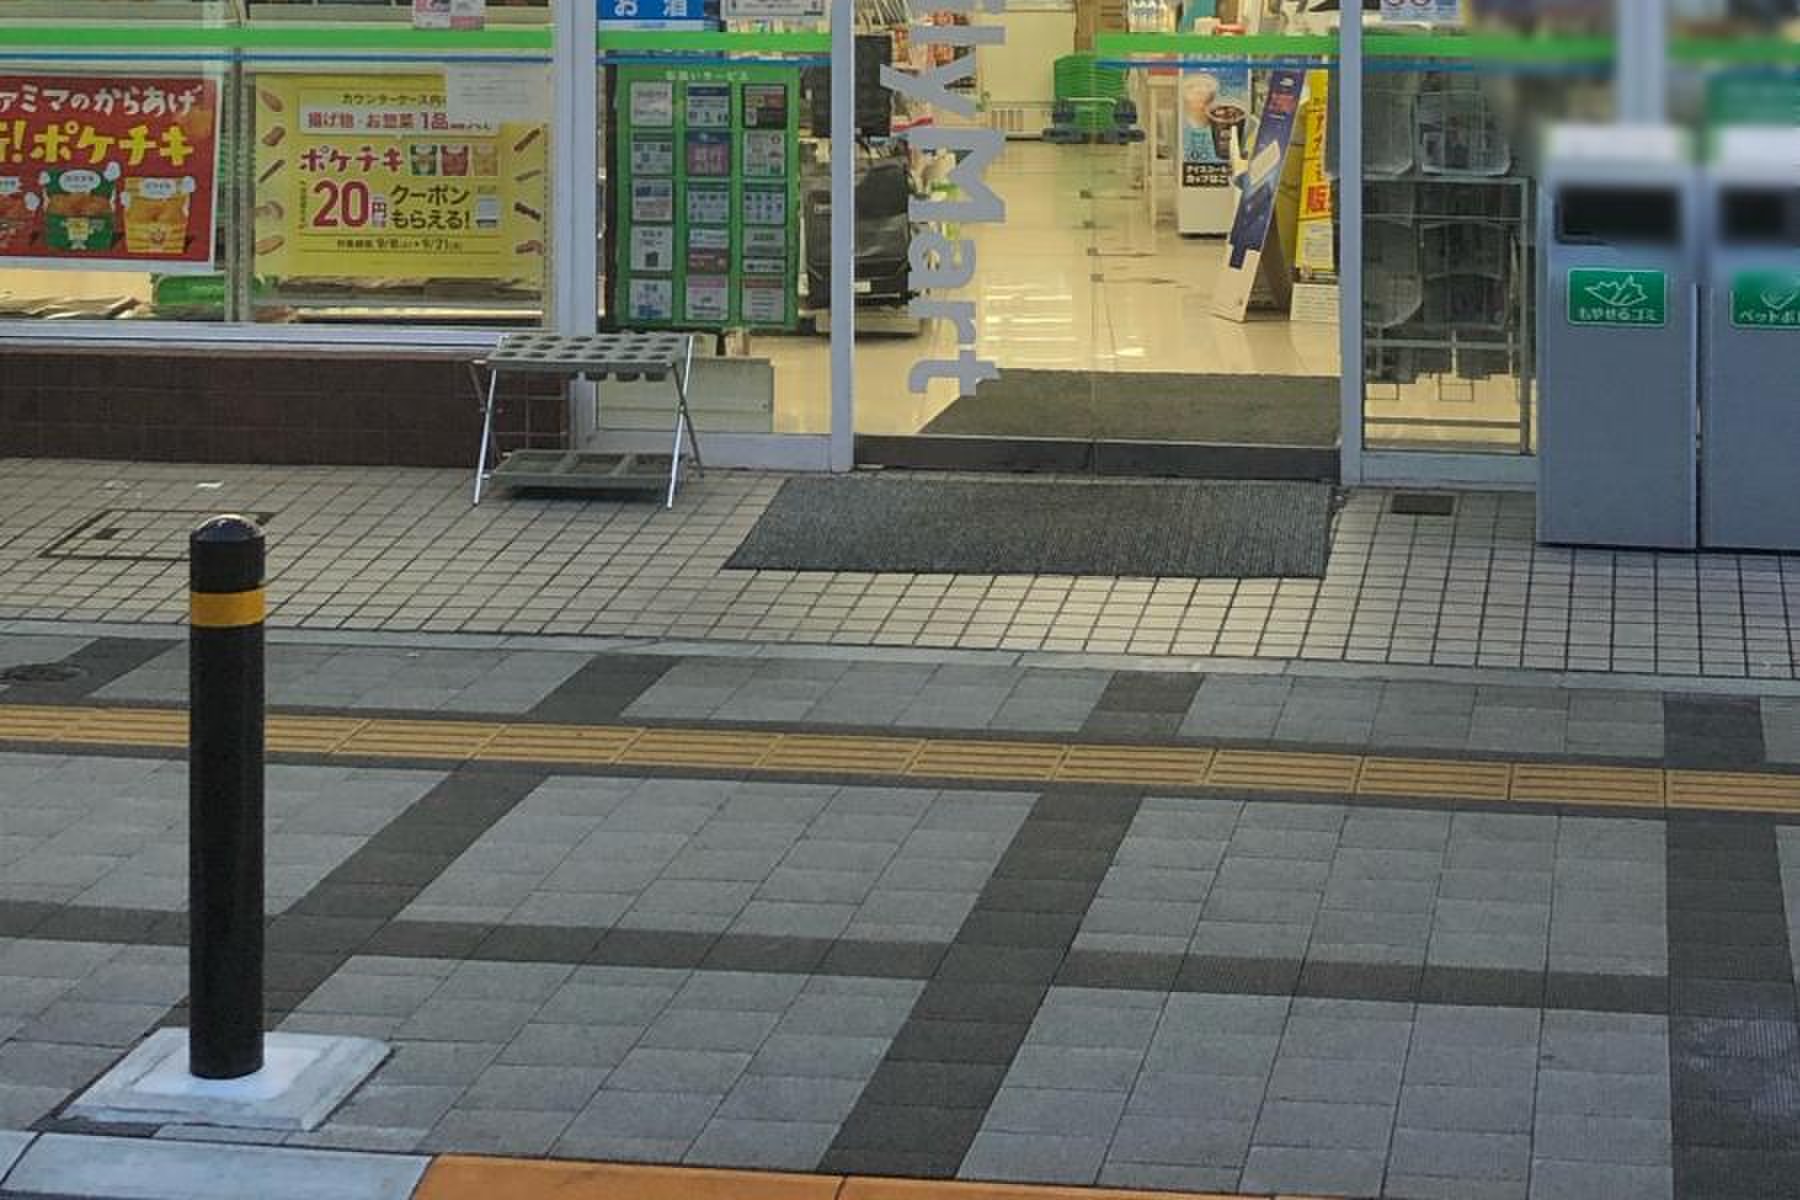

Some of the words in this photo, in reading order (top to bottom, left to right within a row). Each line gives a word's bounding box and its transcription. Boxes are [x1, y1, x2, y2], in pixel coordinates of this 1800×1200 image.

[299, 145, 404, 173] ポケチキ
[391, 183, 471, 205] クーポン
[391, 208, 471, 231] もらえる!
